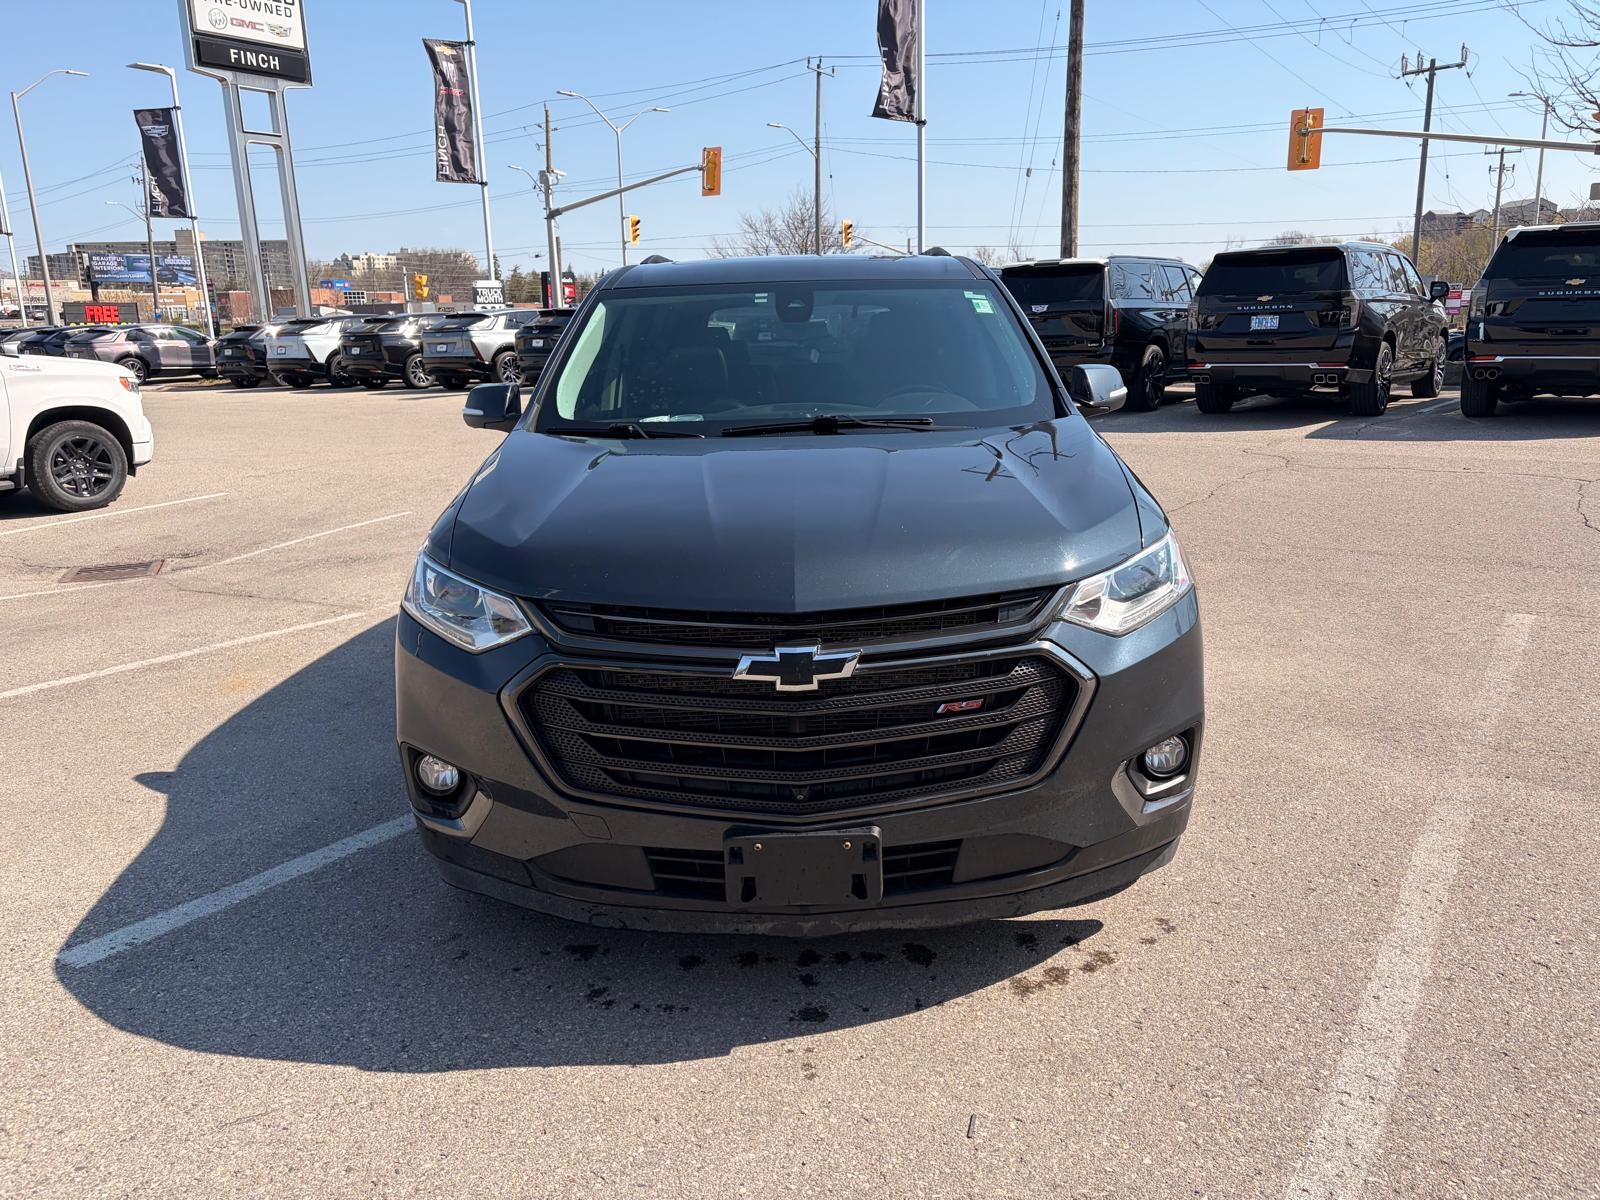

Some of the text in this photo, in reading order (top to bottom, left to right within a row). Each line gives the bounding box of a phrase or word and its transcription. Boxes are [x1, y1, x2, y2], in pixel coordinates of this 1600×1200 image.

[203, 0, 293, 18] E-OWNED
[229, 17, 265, 32] GMC
[229, 48, 281, 71] FINCH
[476, 288, 502, 296] TRUCK
[476, 295, 504, 303] MONTH
[84, 305, 120, 322] FREE
[936, 698, 984, 714] RS
